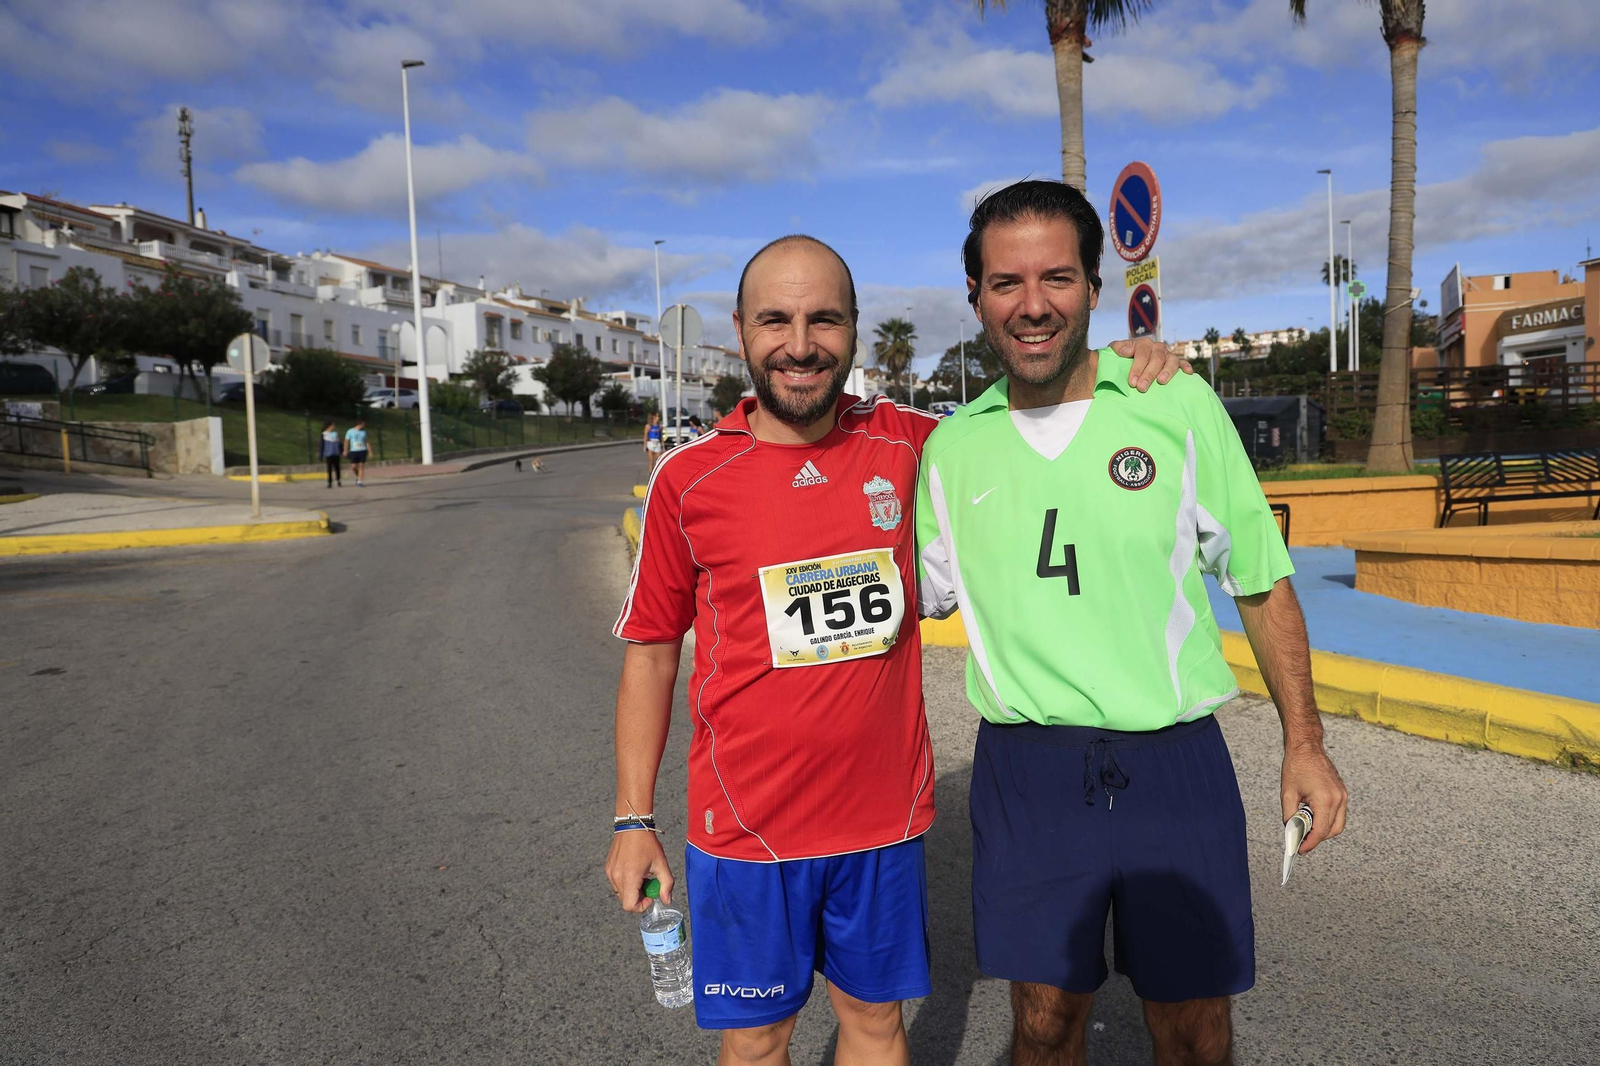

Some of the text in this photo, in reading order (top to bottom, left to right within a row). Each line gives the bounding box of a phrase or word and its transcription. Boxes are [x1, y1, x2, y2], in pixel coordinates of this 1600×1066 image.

[1110, 212, 1121, 250] EXCEPTO
[1120, 244, 1146, 259] SERVICIOS
[1145, 195, 1158, 245] OFICIALES
[1126, 261, 1156, 278] POLICIA
[1129, 271, 1154, 286] LOCAL
[1116, 450, 1149, 462] NIGERIA
[792, 475, 828, 488] adidas
[1112, 464, 1153, 487] FOOTBALL ASSOCIATION
[1036, 508, 1080, 596] 4
[785, 563, 822, 575] XXV EDICIÓN
[785, 561, 879, 586] CARRERA URBANA
[788, 572, 881, 597] CIUDAD DE ALGECIRAS
[784, 583, 893, 636] 156
[809, 627, 875, 645] GALINDO GARCÍA, ENRIQUE
[704, 983, 785, 998] GIVOVA
